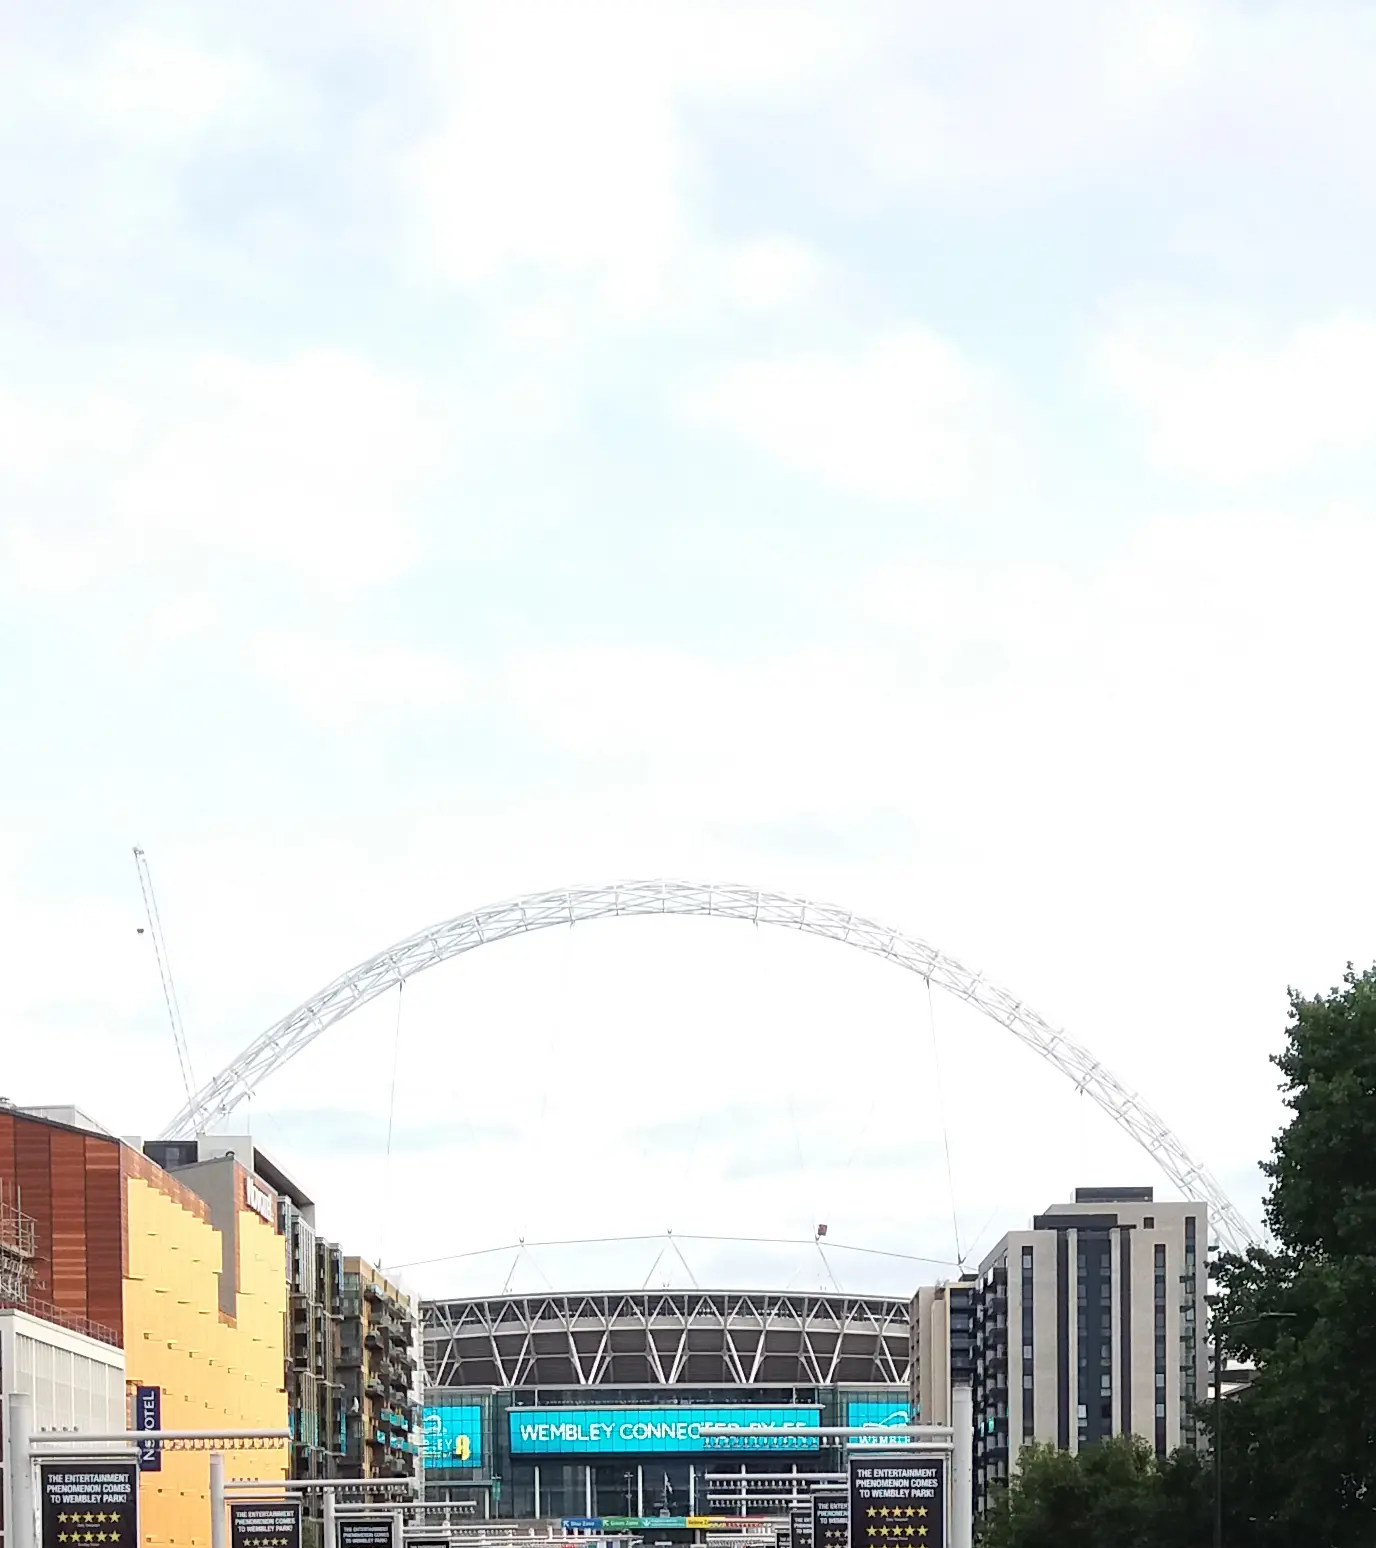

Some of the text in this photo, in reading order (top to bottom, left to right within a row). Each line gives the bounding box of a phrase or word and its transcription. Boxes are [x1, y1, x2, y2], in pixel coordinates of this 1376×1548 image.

[143, 1391, 155, 1460] NOOTEL
[521, 1423, 615, 1441] WEMBLEY
[857, 1469, 936, 1477] THE ENTERTAINMENT
[48, 1474, 129, 1483] THE ENTERTAINMENT
[856, 1479, 938, 1488] PHENOMENON COMES
[46, 1484, 131, 1493] PHENOMENON COMES
[860, 1489, 934, 1498] TO WEMBLEY PARK!
[50, 1494, 127, 1504] TO WEMBLEY PARK!
